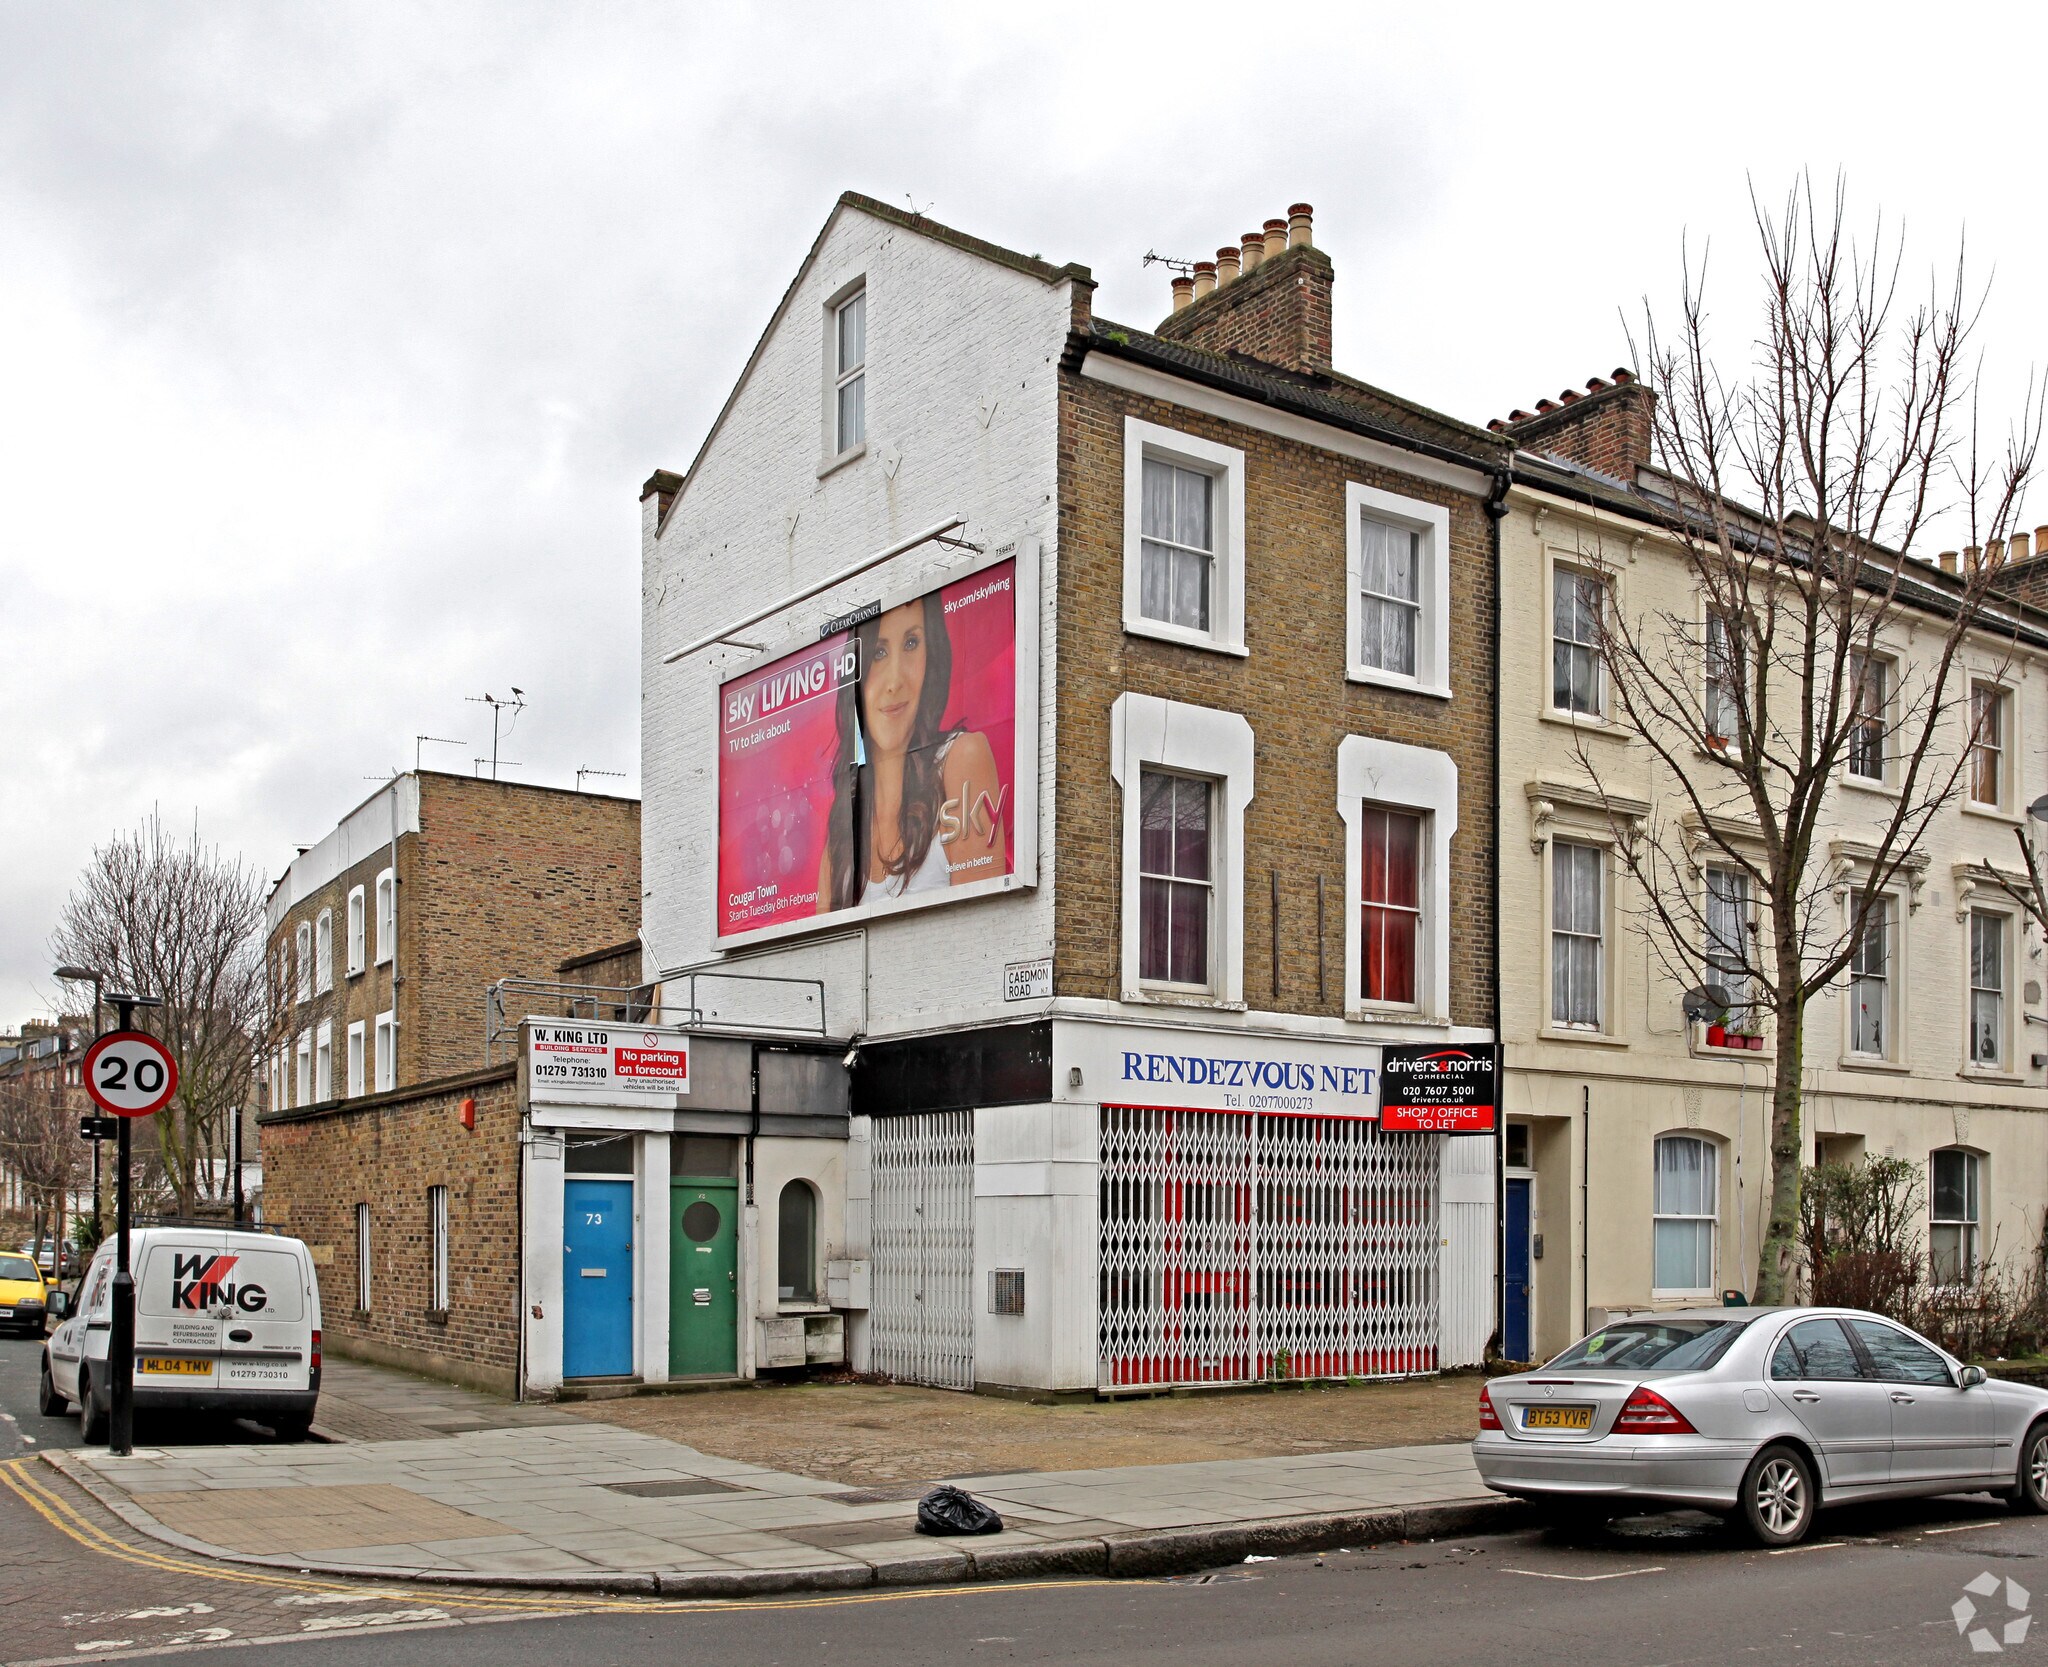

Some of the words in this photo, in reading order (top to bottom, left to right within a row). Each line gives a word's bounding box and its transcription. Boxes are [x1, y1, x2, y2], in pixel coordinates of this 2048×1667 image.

[944, 577, 1010, 614] sky.com/skyliving
[728, 692, 756, 723] sky
[762, 661, 826, 713] LIVING
[833, 652, 857, 681] HD
[729, 739, 740, 753] TV
[740, 736, 750, 749] to
[766, 719, 792, 740] about
[940, 779, 1009, 849] sky
[945, 862, 967, 874] Believe
[966, 859, 974, 868] in
[973, 855, 994, 867] better
[728, 890, 757, 907] Cougar
[756, 884, 778, 901] Town
[728, 909, 749, 923] Starts
[748, 900, 776, 917] Tuesday
[776, 897, 790, 911] 8th
[789, 891, 820, 906] February
[1008, 968, 1049, 984] CAEDMON
[1008, 984, 1032, 998] ROAD
[534, 1029, 549, 1042] W.
[554, 1030, 583, 1043] KING
[587, 1032, 608, 1045] LTD
[539, 1044, 570, 1052] BUILDING
[552, 1055, 591, 1064] Telephone:
[622, 1050, 638, 1060] No
[640, 1052, 679, 1065] parking
[1387, 1056, 1492, 1073] drivers&norris
[100, 1056, 164, 1093] 20
[535, 1064, 567, 1077] 01279
[618, 1065, 632, 1074] on
[635, 1065, 683, 1077] forecourt
[1121, 1051, 1315, 1092] RENDEZVOUS
[1320, 1065, 1376, 1095] NET
[1402, 1086, 1421, 1096] 020
[1425, 1086, 1447, 1096] 7607
[1452, 1086, 1475, 1096] 5001
[1224, 1093, 1245, 1108] Tel.
[1249, 1095, 1313, 1111] 02077000273
[1411, 1096, 1464, 1104] drivers.co.uk
[1396, 1107, 1428, 1118] SHOP
[1430, 1107, 1435, 1118] /
[1437, 1107, 1478, 1118] OFFICE
[1417, 1119, 1433, 1129] TO
[1436, 1119, 1457, 1129] LET
[586, 1213, 602, 1225] 73
[174, 1253, 219, 1280] W
[172, 1281, 267, 1312] KING
[184, 1361, 210, 1372] TMV
[230, 1370, 257, 1378] 01279
[258, 1371, 288, 1379] 730310
[1528, 1411, 1560, 1424] BT53
[1563, 1411, 1588, 1424] YVR
